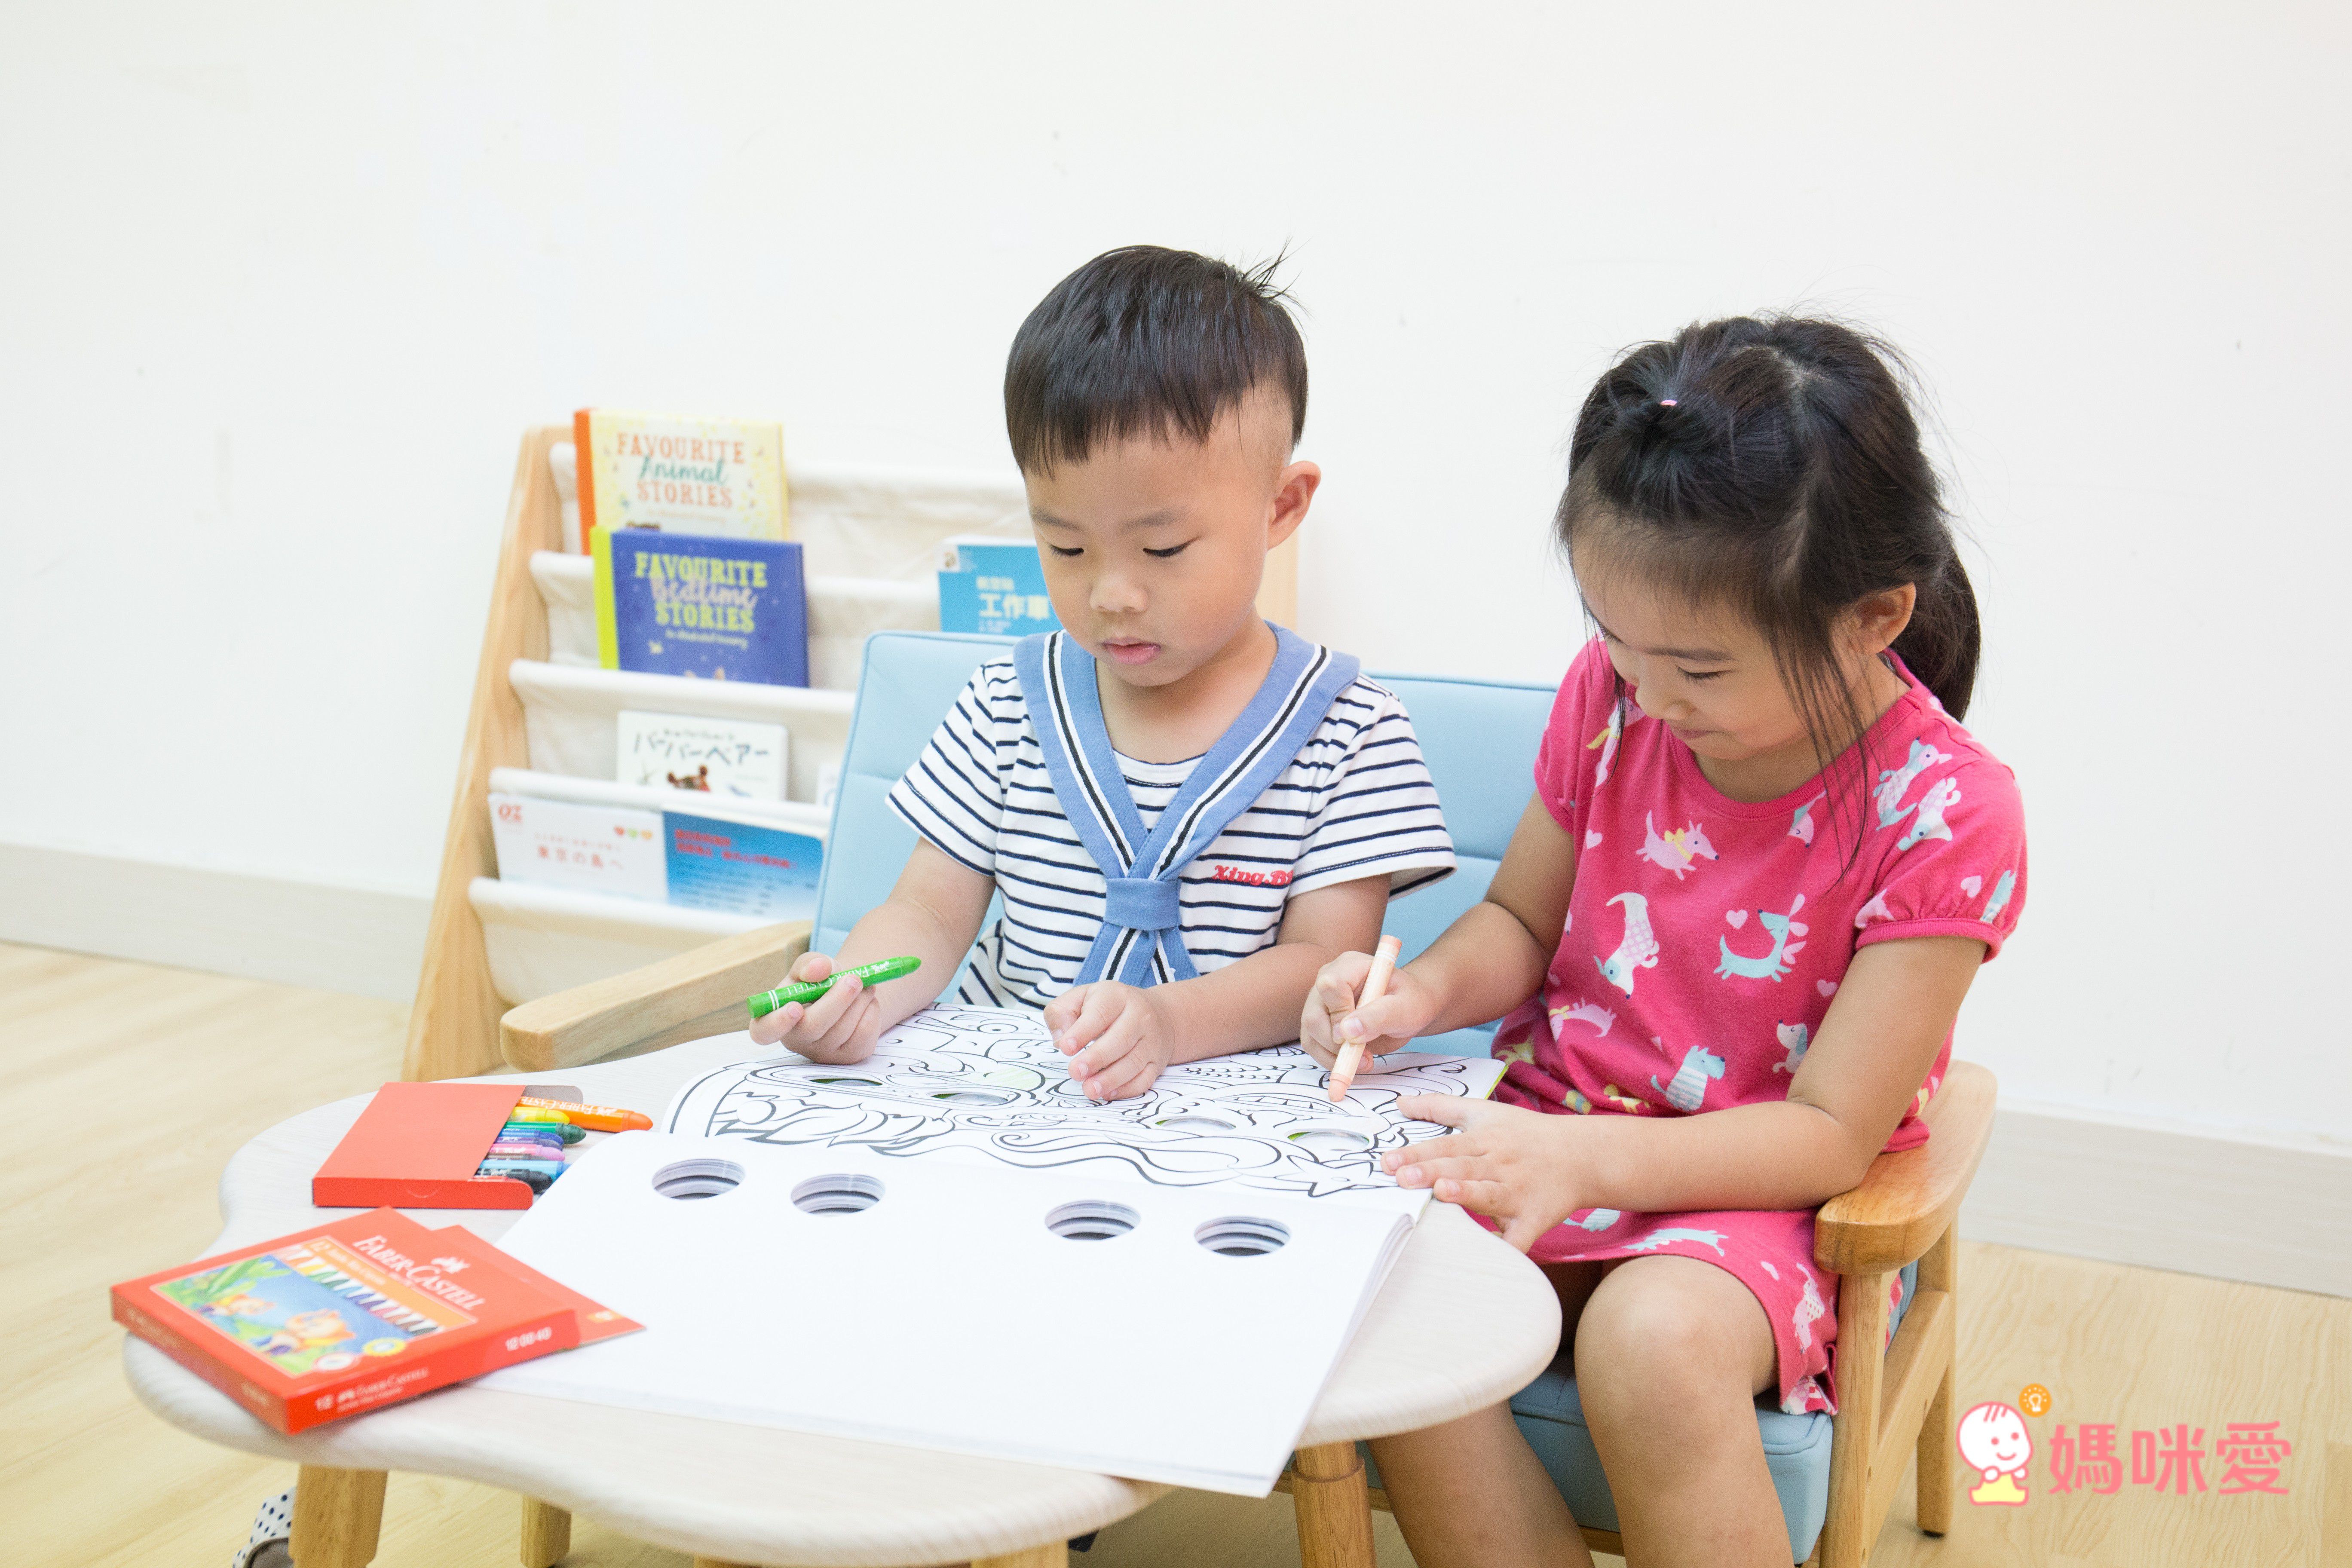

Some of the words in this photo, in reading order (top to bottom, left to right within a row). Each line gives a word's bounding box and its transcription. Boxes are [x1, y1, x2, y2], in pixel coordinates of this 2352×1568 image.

[617, 432, 746, 464] FAVOURITE
[638, 455, 729, 486] Animal
[637, 479, 733, 509] STORIES
[634, 551, 768, 588] FAVOURITE
[655, 602, 756, 634] STORIES
